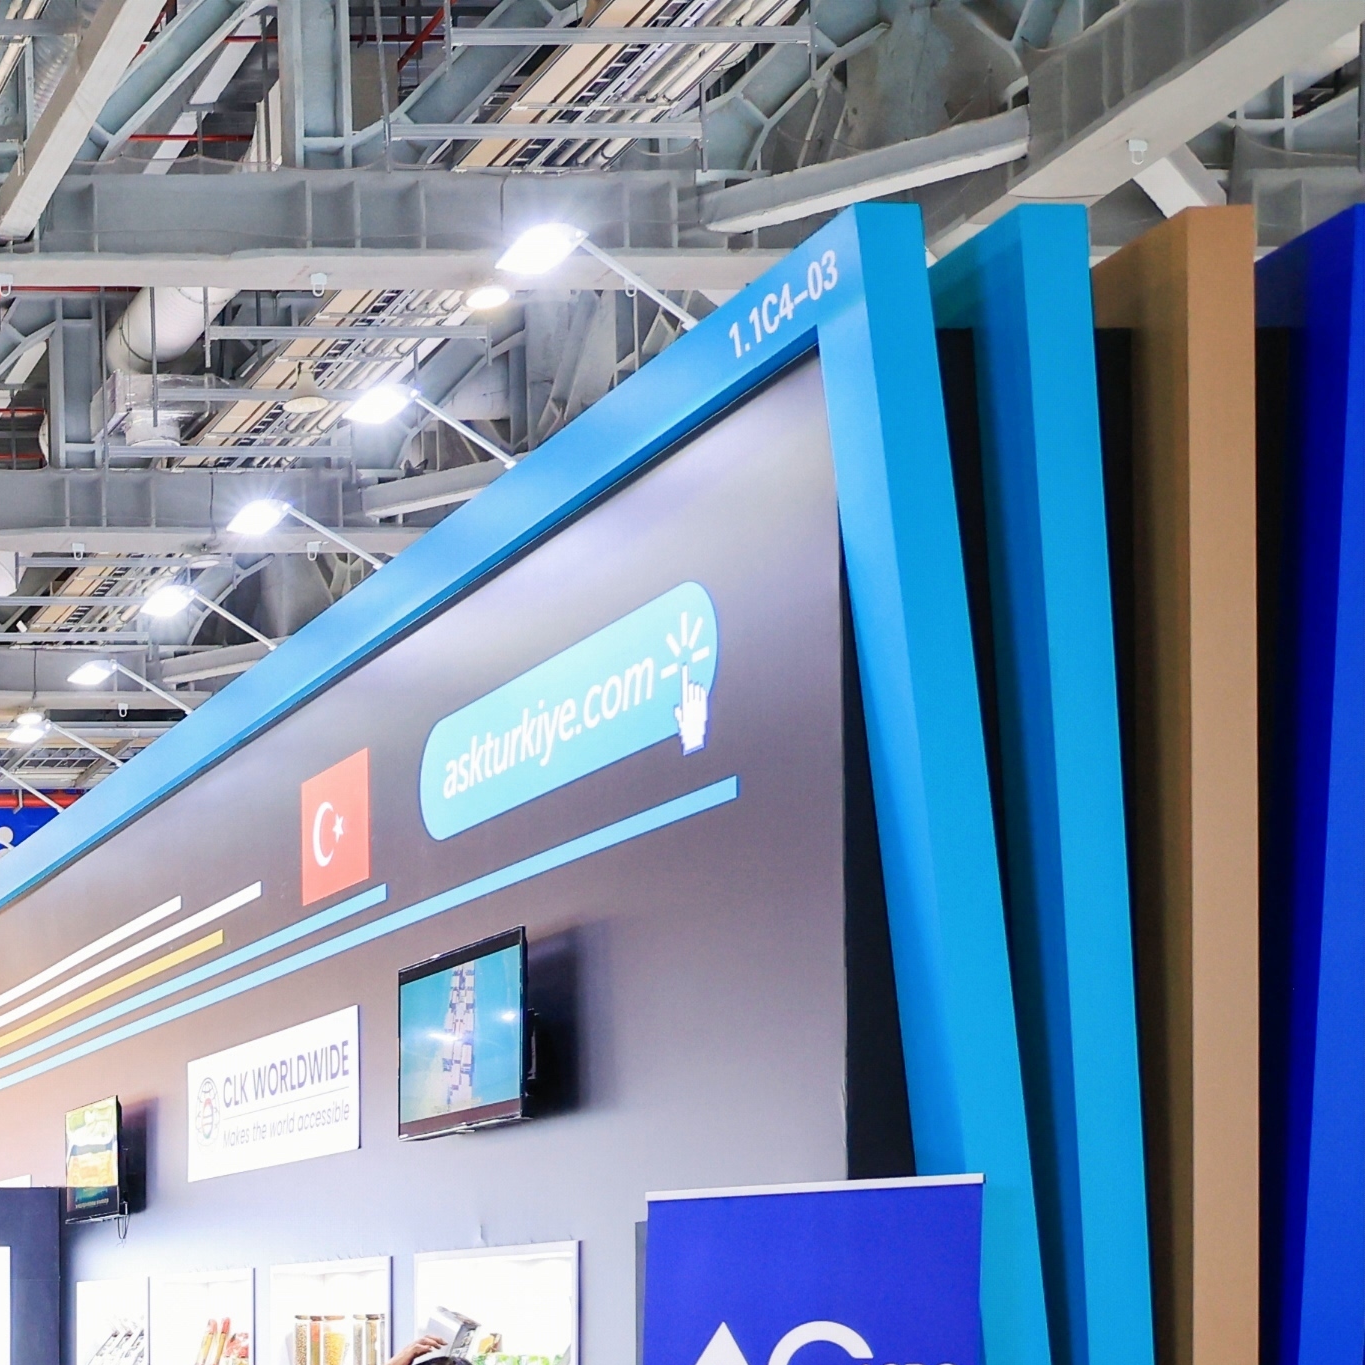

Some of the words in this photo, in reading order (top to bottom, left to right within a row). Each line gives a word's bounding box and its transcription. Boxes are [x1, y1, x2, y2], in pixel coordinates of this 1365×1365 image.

[729, 250, 838, 359] 1.1C4-03
[442, 657, 654, 799] askturkiye.com
[223, 1071, 249, 1108] CLK
[252, 1040, 349, 1101] WORLDWIDE
[223, 1126, 250, 1148] Makes
[253, 1122, 267, 1142] the
[270, 1112, 295, 1137] world
[297, 1099, 350, 1132] accessible
